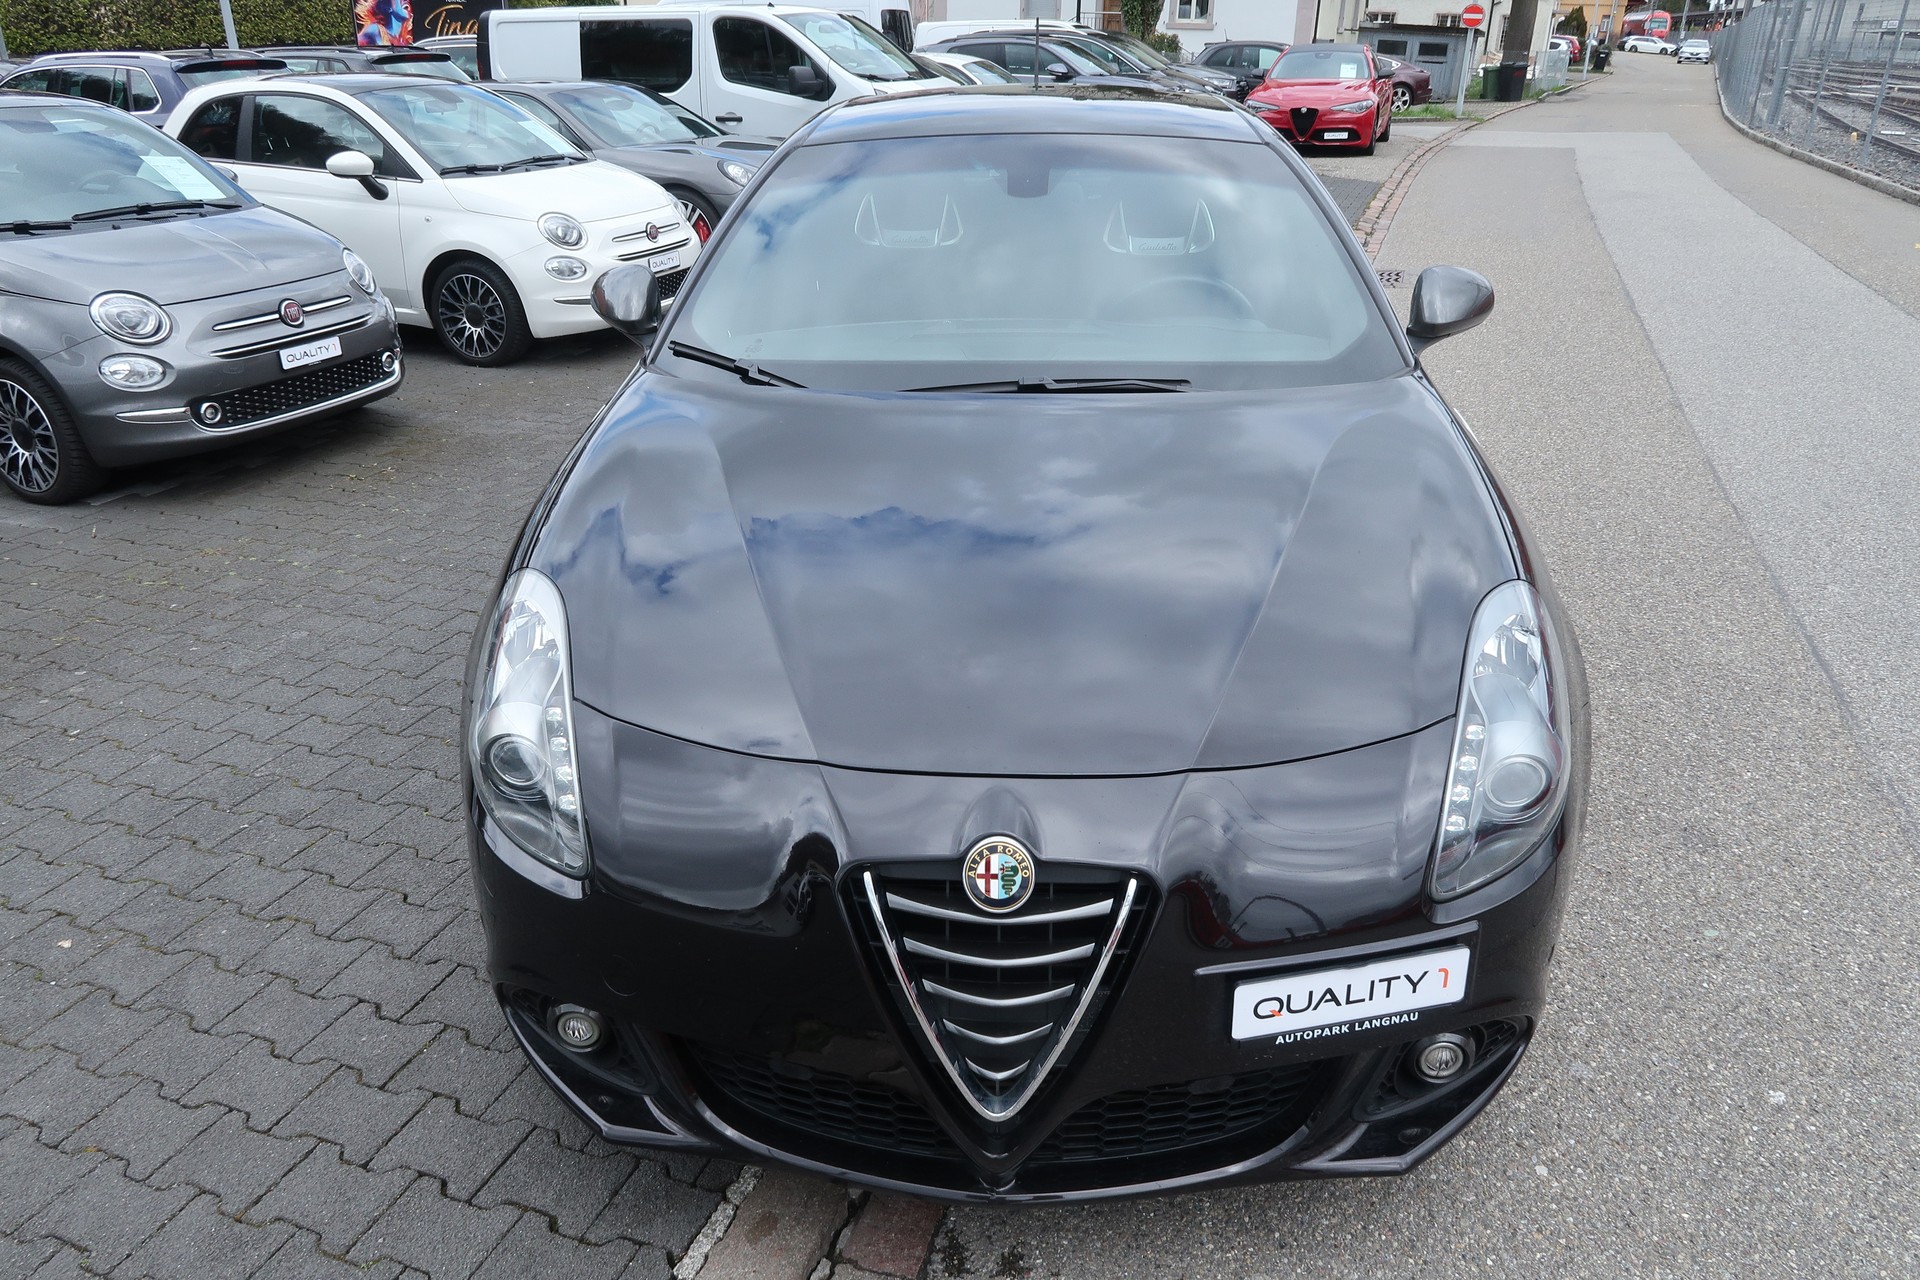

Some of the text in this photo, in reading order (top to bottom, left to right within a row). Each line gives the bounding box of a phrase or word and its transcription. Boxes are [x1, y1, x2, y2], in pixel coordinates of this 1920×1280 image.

[424, 4, 479, 39] Tina
[652, 256, 675, 269] QUALITY
[286, 344, 331, 363] QUALITY
[968, 845, 1030, 878] ALFA ROMEO
[1253, 967, 1449, 1020] QUALITY 1
[1275, 1011, 1419, 1045] AUTOPARK LANGNAU
